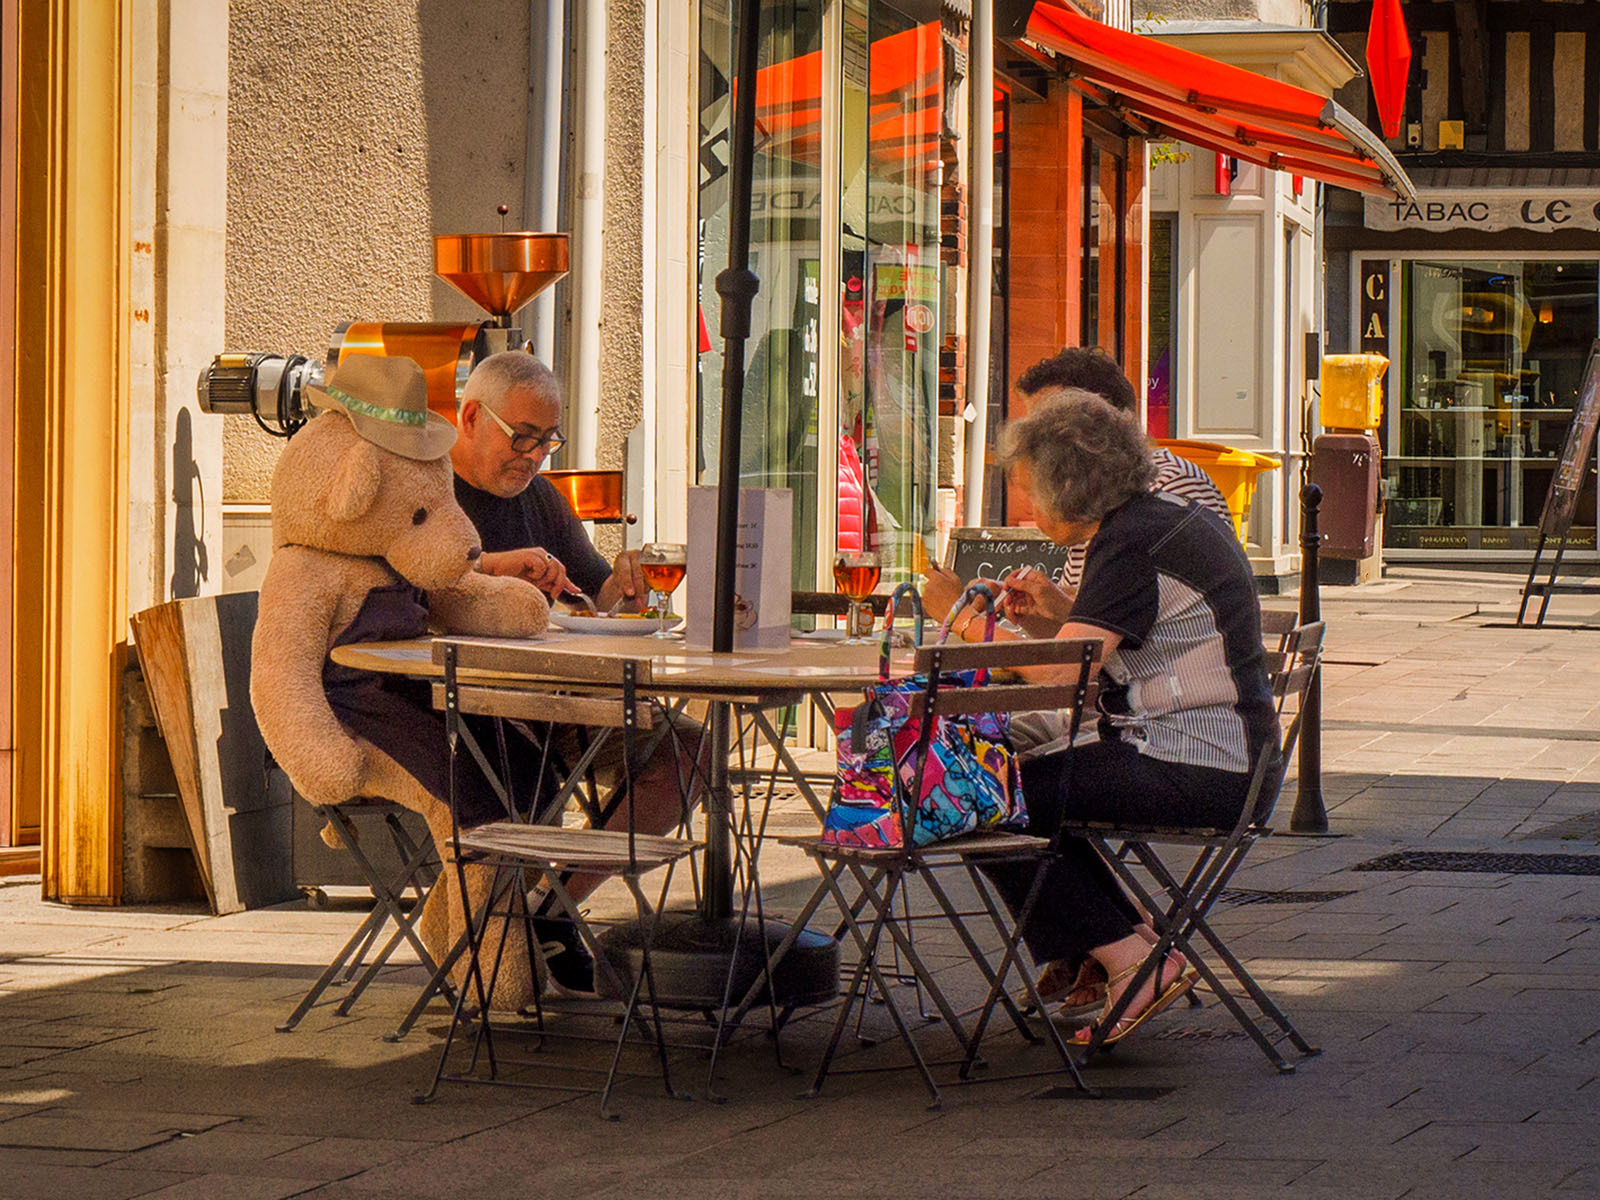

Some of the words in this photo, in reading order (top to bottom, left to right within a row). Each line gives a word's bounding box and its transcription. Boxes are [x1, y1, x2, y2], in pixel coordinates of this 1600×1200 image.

[1388, 202, 1490, 221] TABAC
[1520, 199, 1572, 223] LE
[1365, 274, 1385, 338] CA
